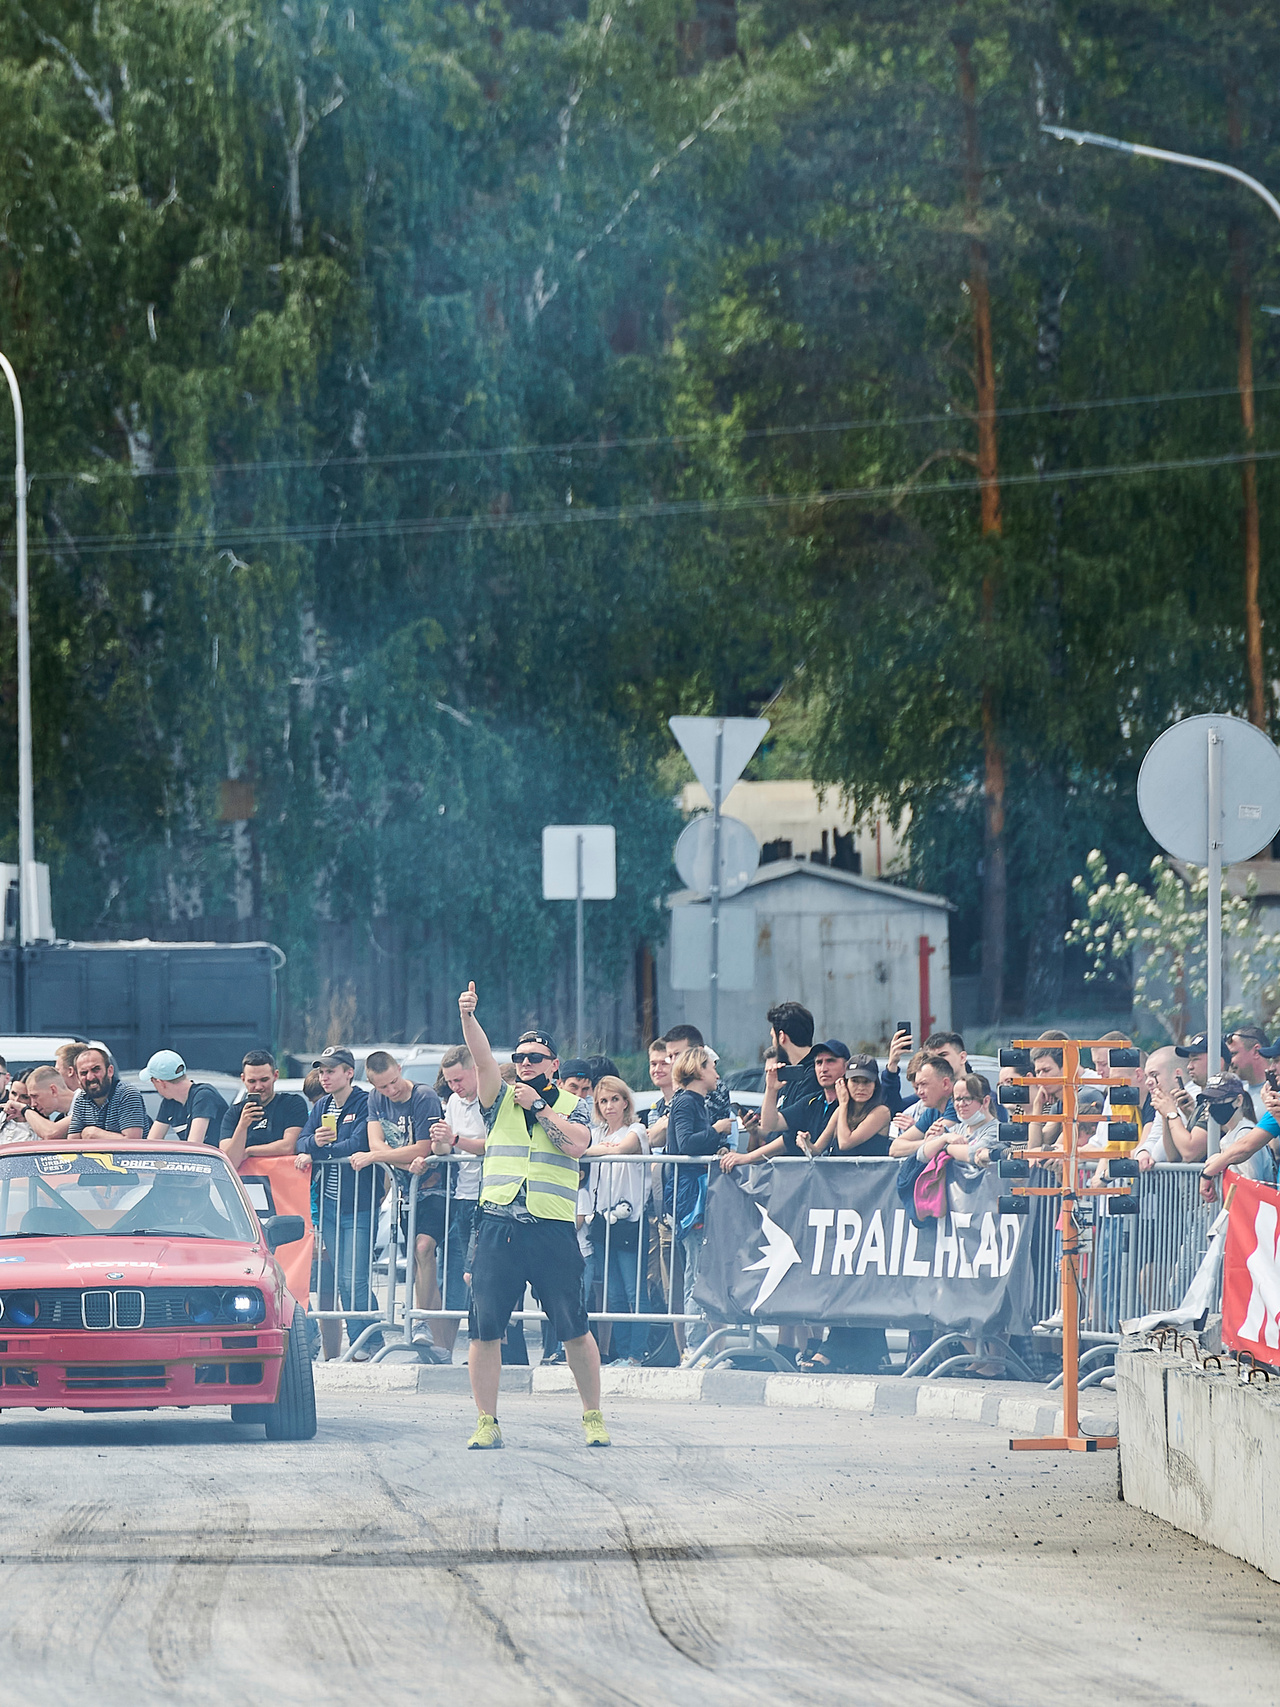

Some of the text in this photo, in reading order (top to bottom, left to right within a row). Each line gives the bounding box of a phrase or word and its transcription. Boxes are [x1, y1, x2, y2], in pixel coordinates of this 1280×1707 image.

[42, 1159, 71, 1167] URBAN
[166, 1163, 212, 1174] GAMES
[808, 1208, 1021, 1279] TRAILHEAD
[66, 1261, 165, 1270] MOTUL
